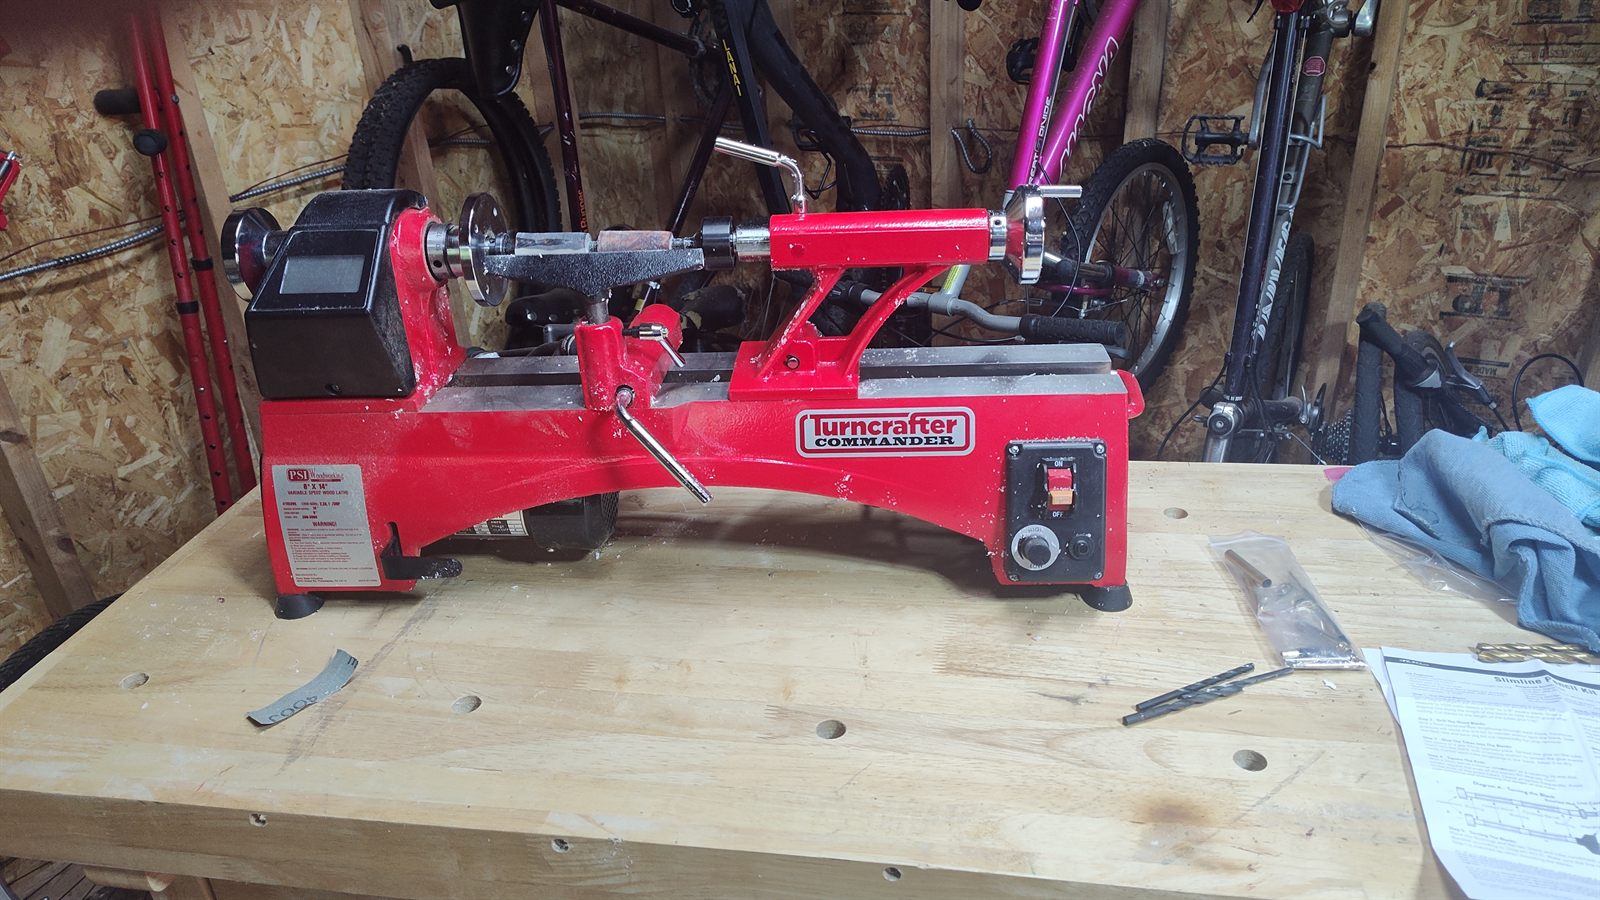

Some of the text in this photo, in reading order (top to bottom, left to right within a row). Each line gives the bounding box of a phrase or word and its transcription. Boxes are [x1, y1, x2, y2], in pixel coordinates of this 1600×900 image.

[722, 39, 742, 97] LANAI
[1027, 95, 1052, 186] REAT DIVIDE
[811, 412, 957, 437] Turncrafter
[815, 435, 955, 448] COMMANDER
[289, 469, 308, 480] PSI
[1494, 676, 1542, 685] Slimline
